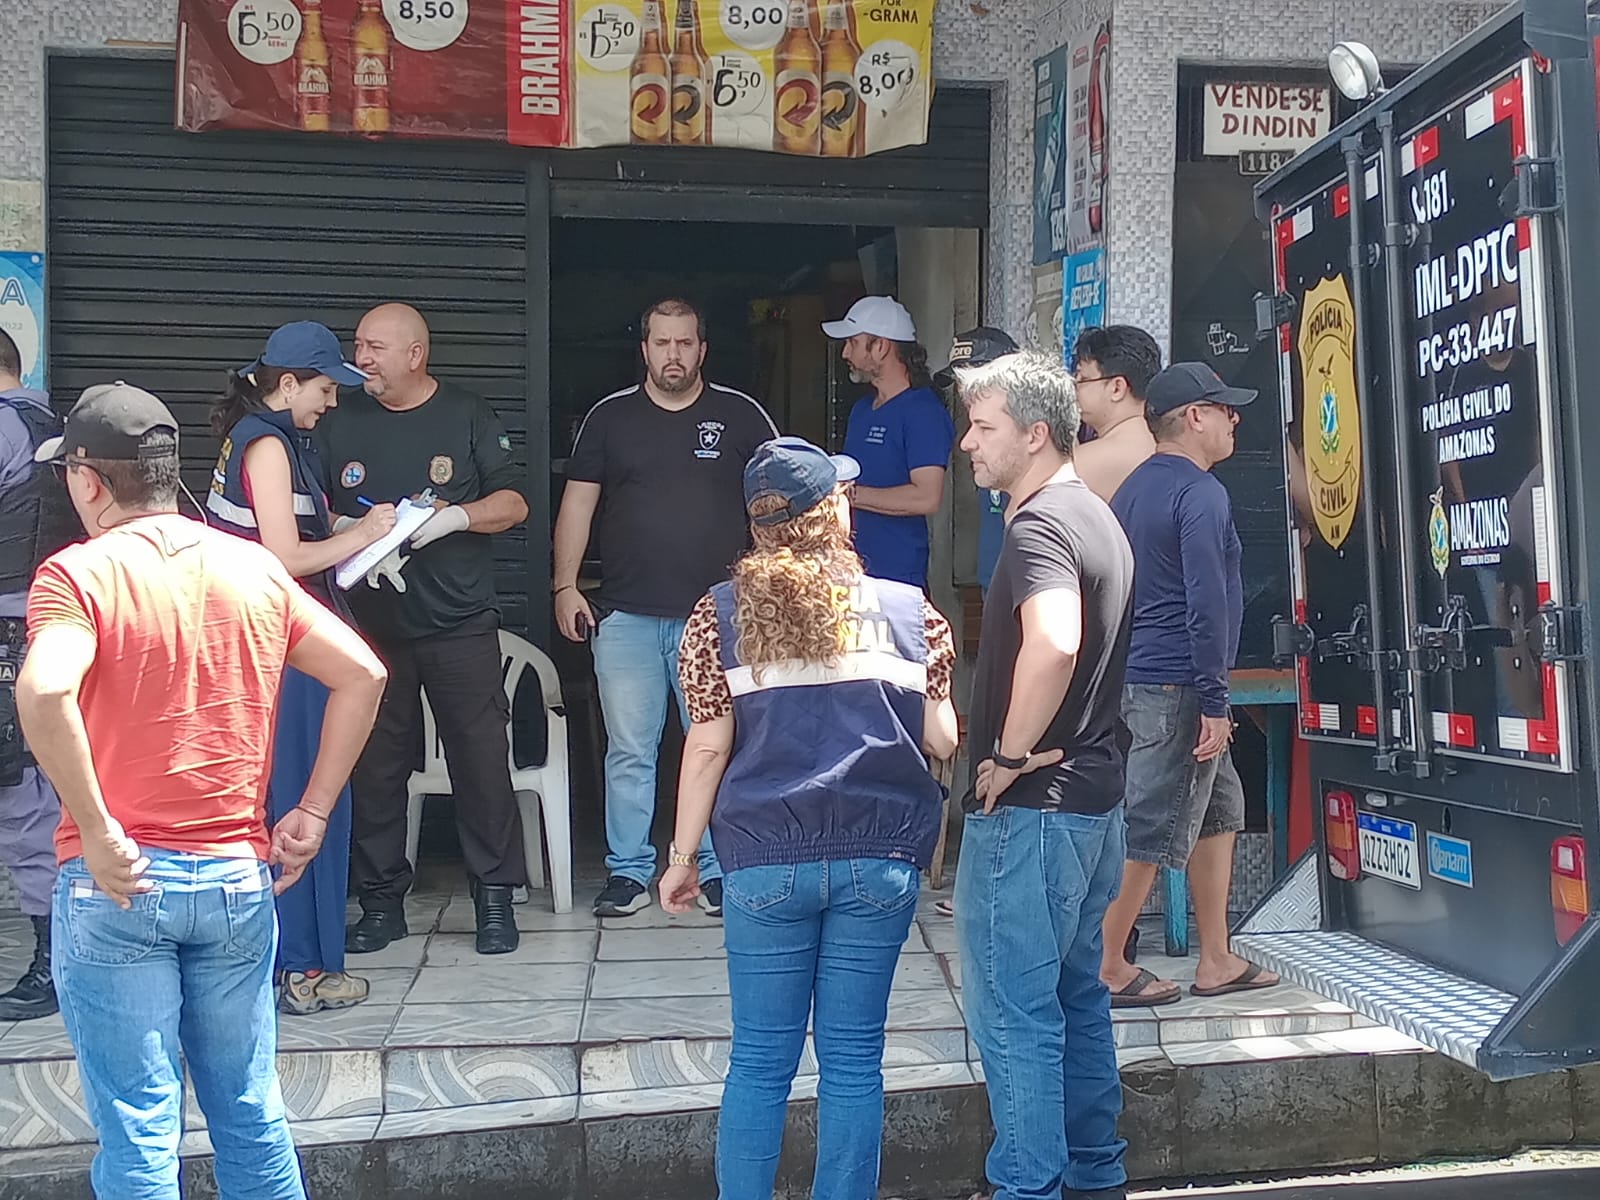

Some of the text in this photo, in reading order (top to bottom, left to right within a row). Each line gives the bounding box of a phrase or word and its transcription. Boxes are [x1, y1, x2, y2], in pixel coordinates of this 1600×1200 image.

[399, 0, 455, 25] 8,50
[727, 5, 783, 30] 8,00
[519, 0, 561, 116] BRAHM
[871, 51, 891, 66] R$
[1210, 84, 1325, 114] VENDE-SE
[1221, 112, 1317, 139] DINDIN
[1247, 152, 1292, 172] 118
[1414, 221, 1519, 320] IML-DPTC
[1418, 306, 1518, 378] PC-33.447
[1422, 383, 1512, 433] POLÍCIA CIVIL DO
[1438, 425, 1496, 465] AMAZONAS
[1320, 482, 1347, 512] CIVIL
[1450, 496, 1511, 552] AMAZONAS
